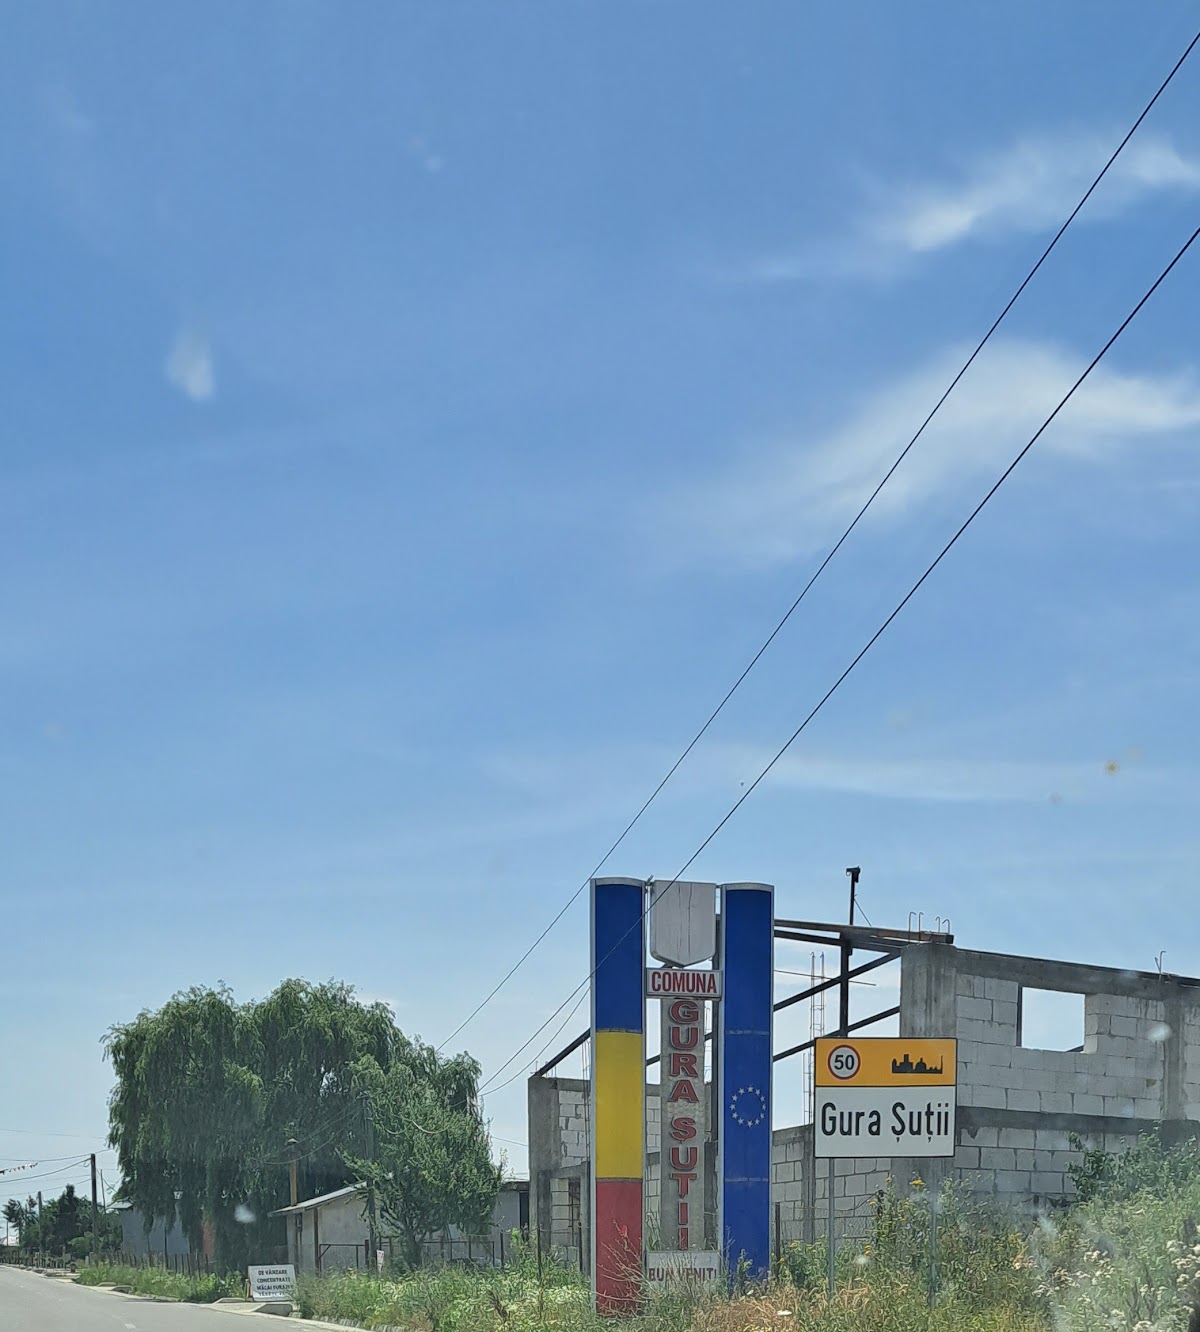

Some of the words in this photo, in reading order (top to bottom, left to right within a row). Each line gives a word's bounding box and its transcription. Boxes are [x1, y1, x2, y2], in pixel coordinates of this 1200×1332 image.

[651, 971, 717, 994] COMUNA
[670, 1000, 699, 1102] GURA
[834, 1054, 855, 1071] 50
[821, 1102, 881, 1136] Gura
[891, 1101, 949, 1143] Șuții
